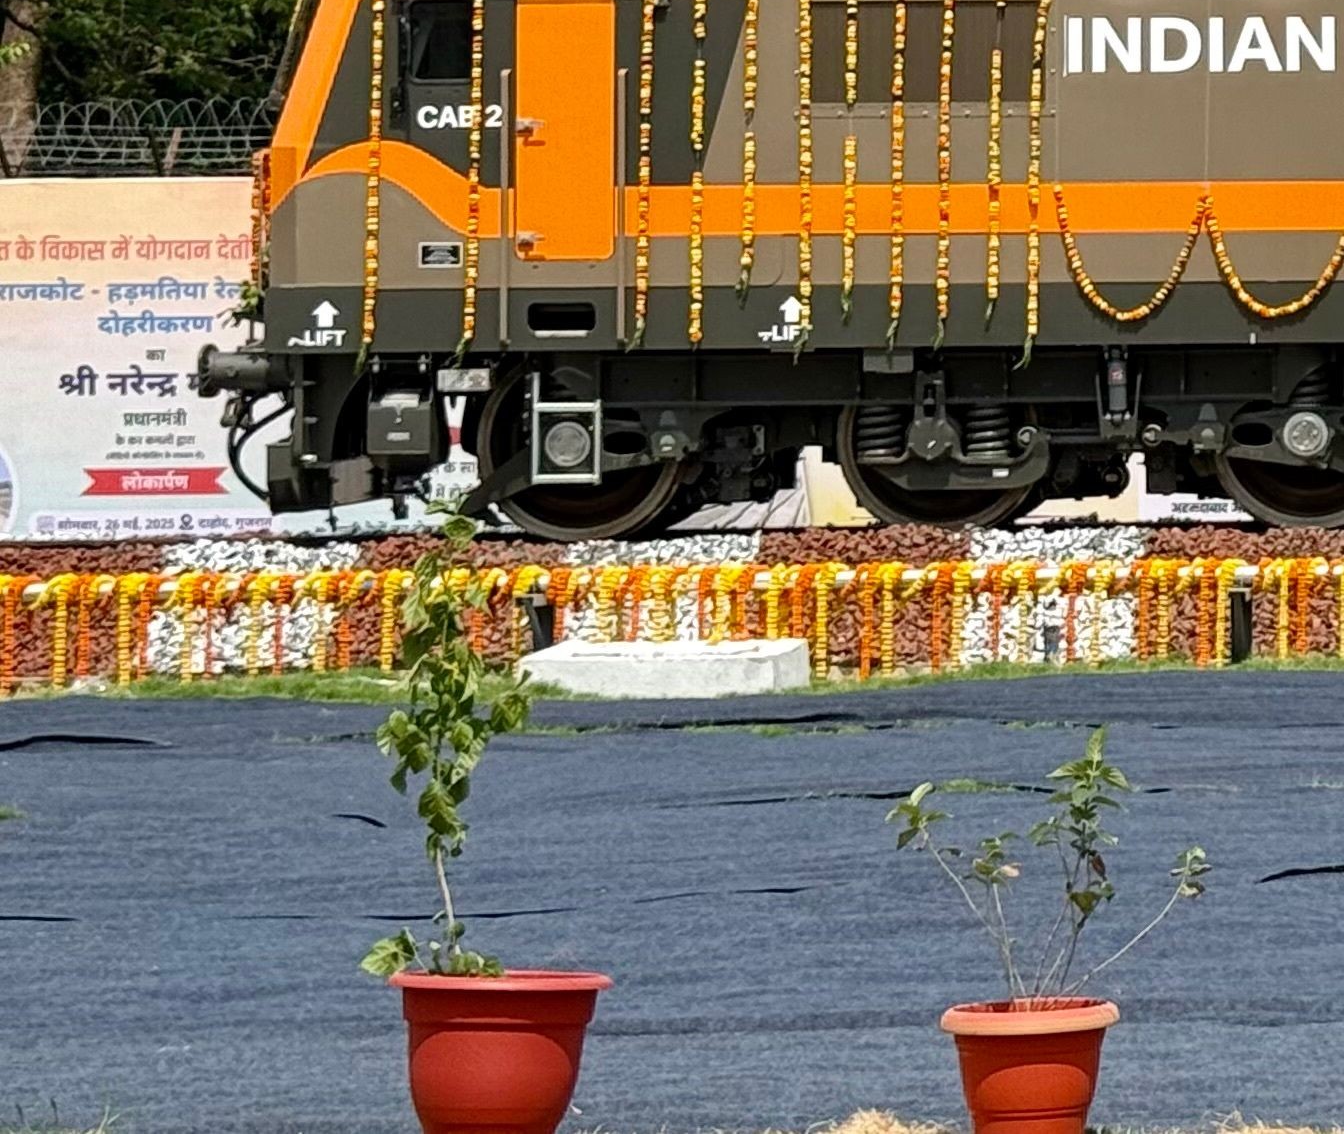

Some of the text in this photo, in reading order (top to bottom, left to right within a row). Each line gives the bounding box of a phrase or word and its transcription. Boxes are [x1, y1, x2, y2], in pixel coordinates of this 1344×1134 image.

[1067, 16, 1336, 73] INDIAN
[417, 104, 503, 129] CAB 2
[16, 234, 34, 260] के
[40, 234, 106, 260] विकास
[111, 234, 133, 260] में
[136, 234, 211, 260] योगदान
[217, 233, 250, 260] देती
[0, 276, 85, 301] राजकोट
[107, 276, 208, 305] हड़मतिया
[97, 309, 213, 336] दोहरीकरण
[304, 330, 347, 346] LIFT
[146, 348, 166, 362] का
[58, 364, 99, 396] श्री
[106, 364, 178, 397] नरेन्द्र
[123, 408, 188, 426] प्रधानमंत्री
[121, 470, 189, 491] लोकार्पण
[105, 517, 120, 531] 26
[145, 517, 175, 530] 2025
